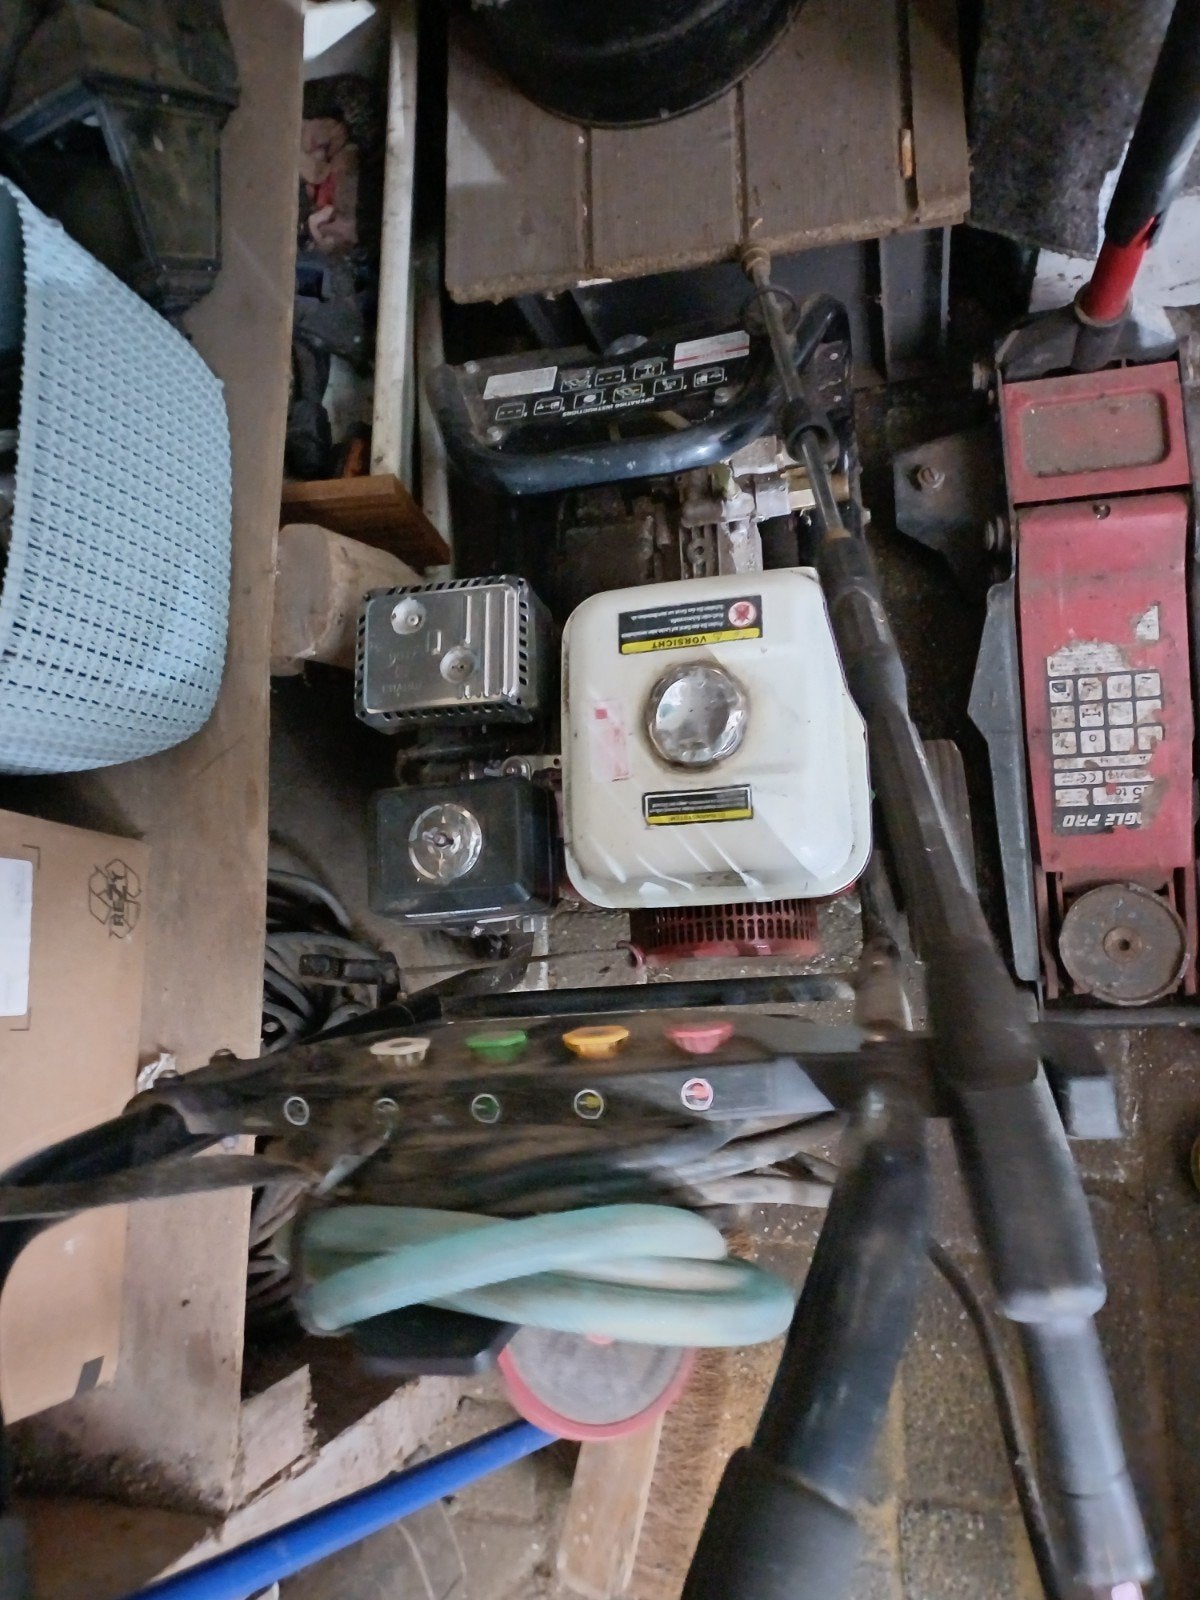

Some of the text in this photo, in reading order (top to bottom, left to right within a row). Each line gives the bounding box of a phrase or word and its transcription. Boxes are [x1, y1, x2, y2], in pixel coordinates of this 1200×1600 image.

[562, 403, 614, 417] INSTRUCTIONS
[651, 635, 707, 649] VORSICHT
[1062, 813, 1101, 828] PRO
[107, 871, 128, 927] REZY
